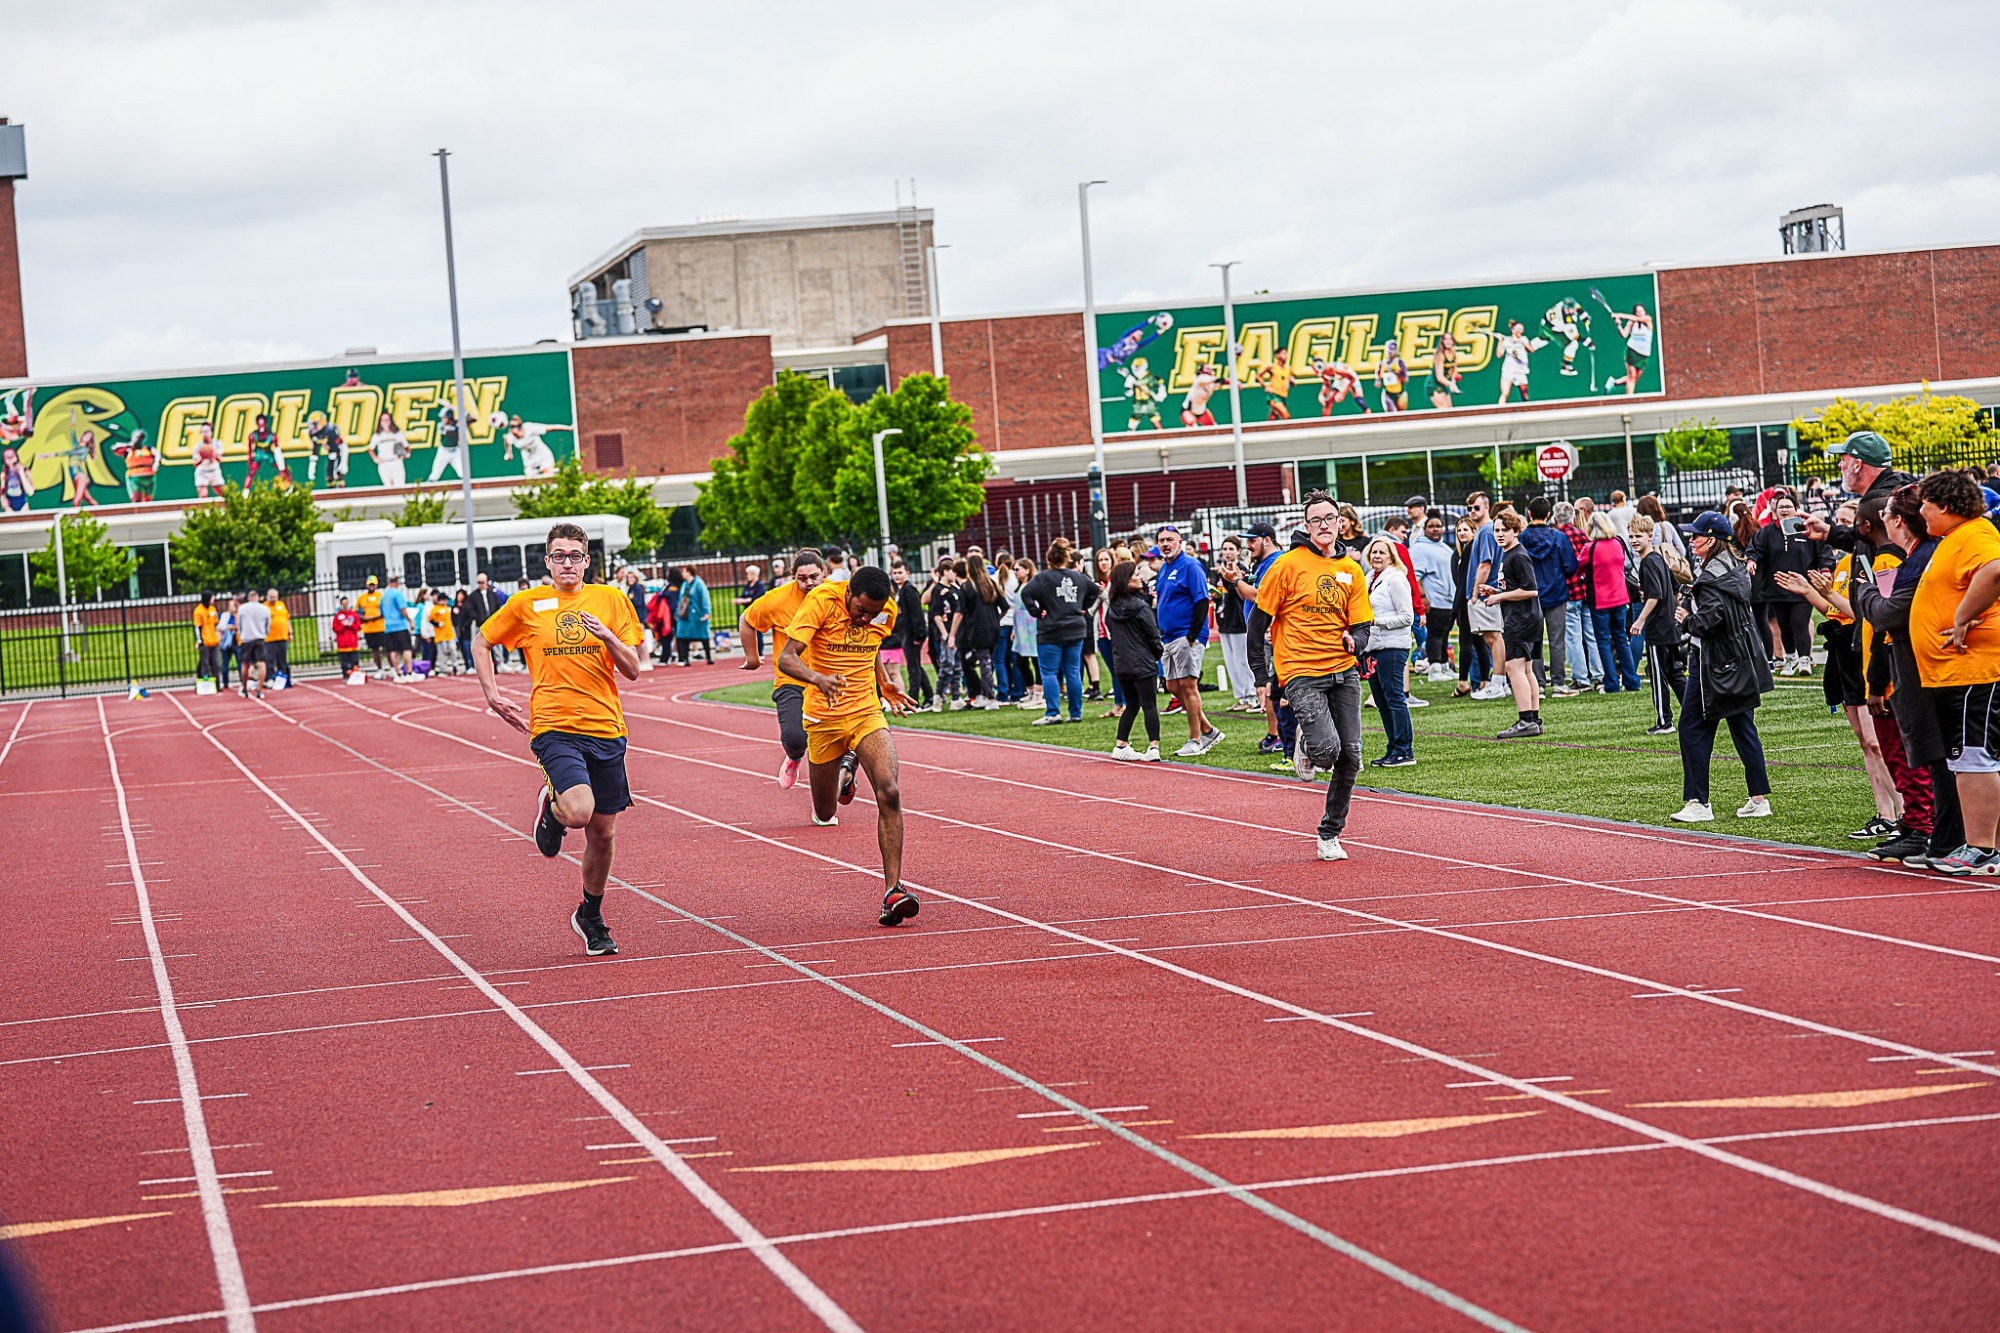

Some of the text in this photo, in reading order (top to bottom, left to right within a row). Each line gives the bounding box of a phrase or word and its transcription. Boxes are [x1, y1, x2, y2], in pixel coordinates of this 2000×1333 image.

[1168, 305, 1498, 394] EAGLES
[156, 376, 508, 466] GOLDEN
[542, 645, 601, 657] SPENCERPORT
[826, 643, 878, 654] SPENCERPORT
